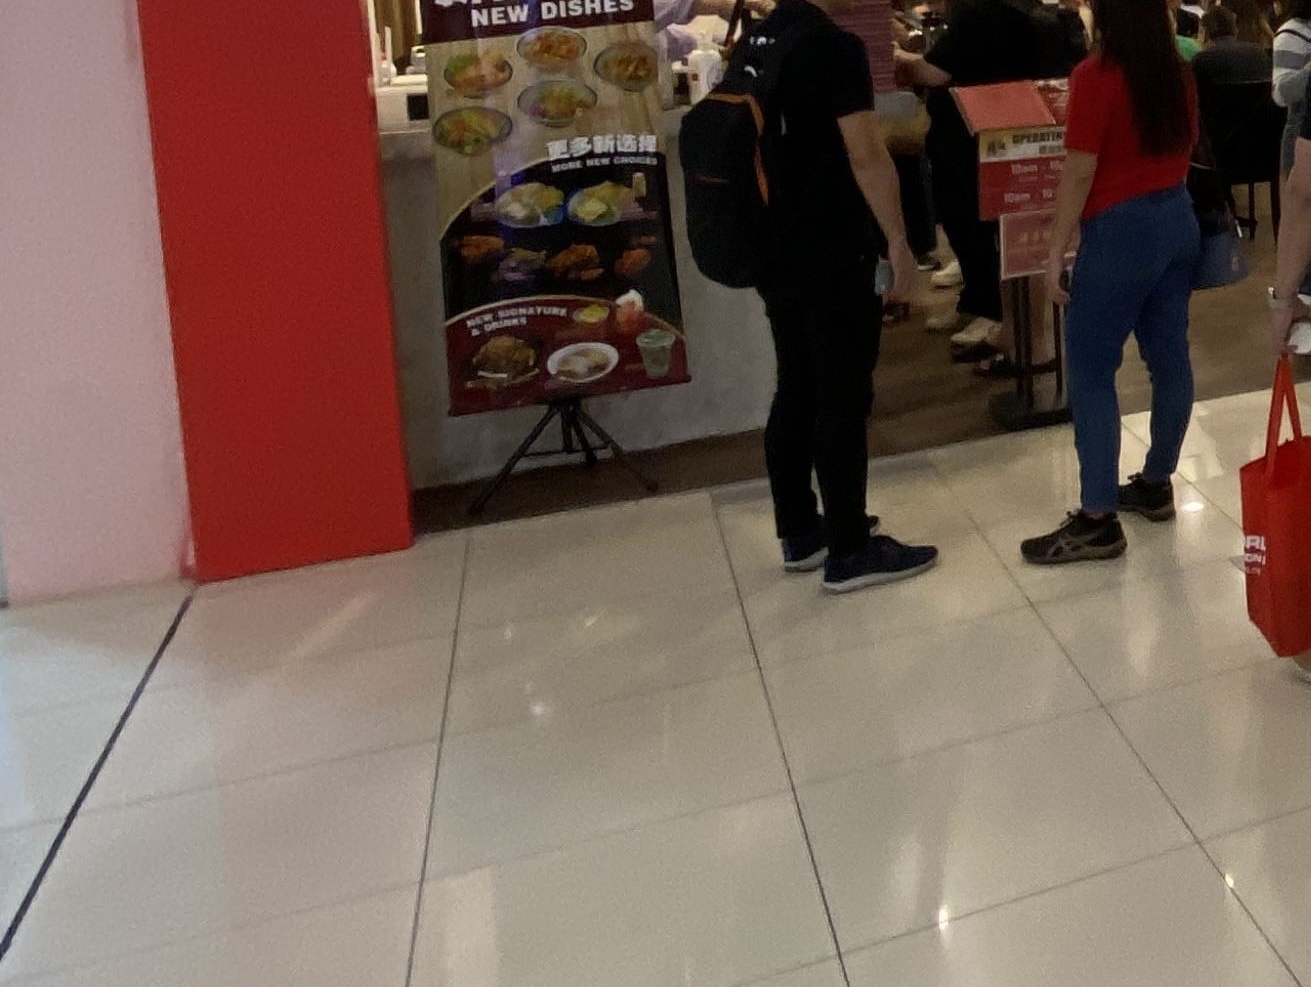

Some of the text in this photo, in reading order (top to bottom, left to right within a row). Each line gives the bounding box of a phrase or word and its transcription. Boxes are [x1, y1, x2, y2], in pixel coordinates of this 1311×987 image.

[471, 3, 529, 28] NEW
[551, 160, 583, 173] MORE
[586, 157, 611, 167] NEW
